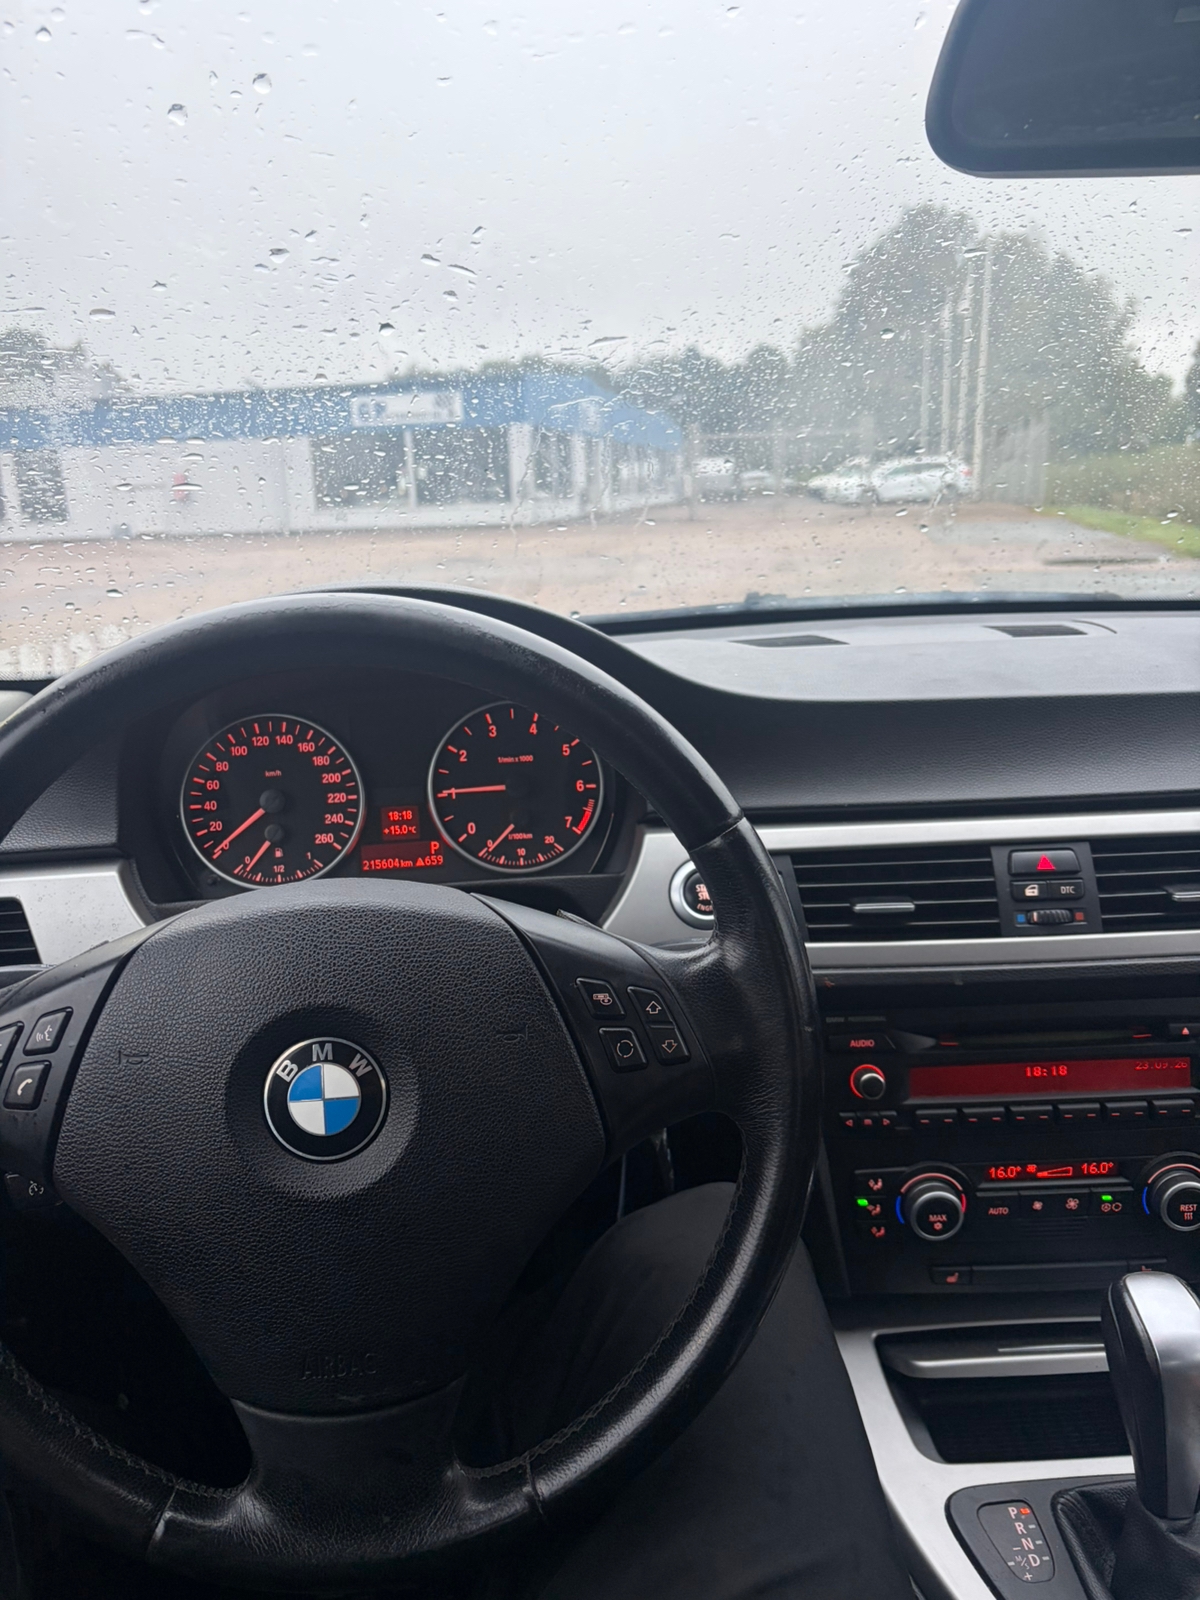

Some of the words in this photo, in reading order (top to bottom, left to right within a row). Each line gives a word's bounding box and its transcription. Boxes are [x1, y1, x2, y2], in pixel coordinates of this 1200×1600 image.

[488, 725, 497, 738] 3
[529, 723, 538, 735] 4
[252, 736, 270, 747] 120
[275, 734, 293, 745] 140
[231, 745, 248, 756] 100
[297, 742, 315, 753] 160
[562, 744, 571, 756] 5
[312, 755, 330, 766] 180
[459, 749, 468, 762] 2
[519, 754, 534, 762] 1000
[216, 761, 229, 772] 80
[265, 769, 282, 777] km/h
[322, 773, 341, 784] 200
[206, 780, 220, 790] 60
[576, 780, 585, 792] 6
[327, 793, 347, 803] 220
[204, 801, 217, 811] 40
[325, 813, 344, 824] 240
[388, 810, 413, 821] 18:18
[209, 822, 223, 832] 20
[564, 816, 573, 828] 7
[467, 822, 476, 835] 0
[315, 833, 334, 844] 260
[544, 836, 555, 844] 20
[430, 841, 440, 855] P
[517, 848, 526, 856] 10
[244, 855, 251, 864] 0
[306, 852, 312, 860] 1
[273, 865, 285, 873] 1/2
[1060, 886, 1076, 894] DTC
[849, 1039, 875, 1048] AUDIO
[276, 1043, 373, 1083] BMW
[1025, 1065, 1068, 1077] 18:18
[988, 1207, 1009, 1215] AUTO
[1180, 1204, 1198, 1212] REST
[929, 1214, 947, 1222] MAX
[1008, 1507, 1018, 1519] P
[1014, 1522, 1027, 1535] R
[1021, 1537, 1035, 1551] N
[1027, 1553, 1040, 1567] D
